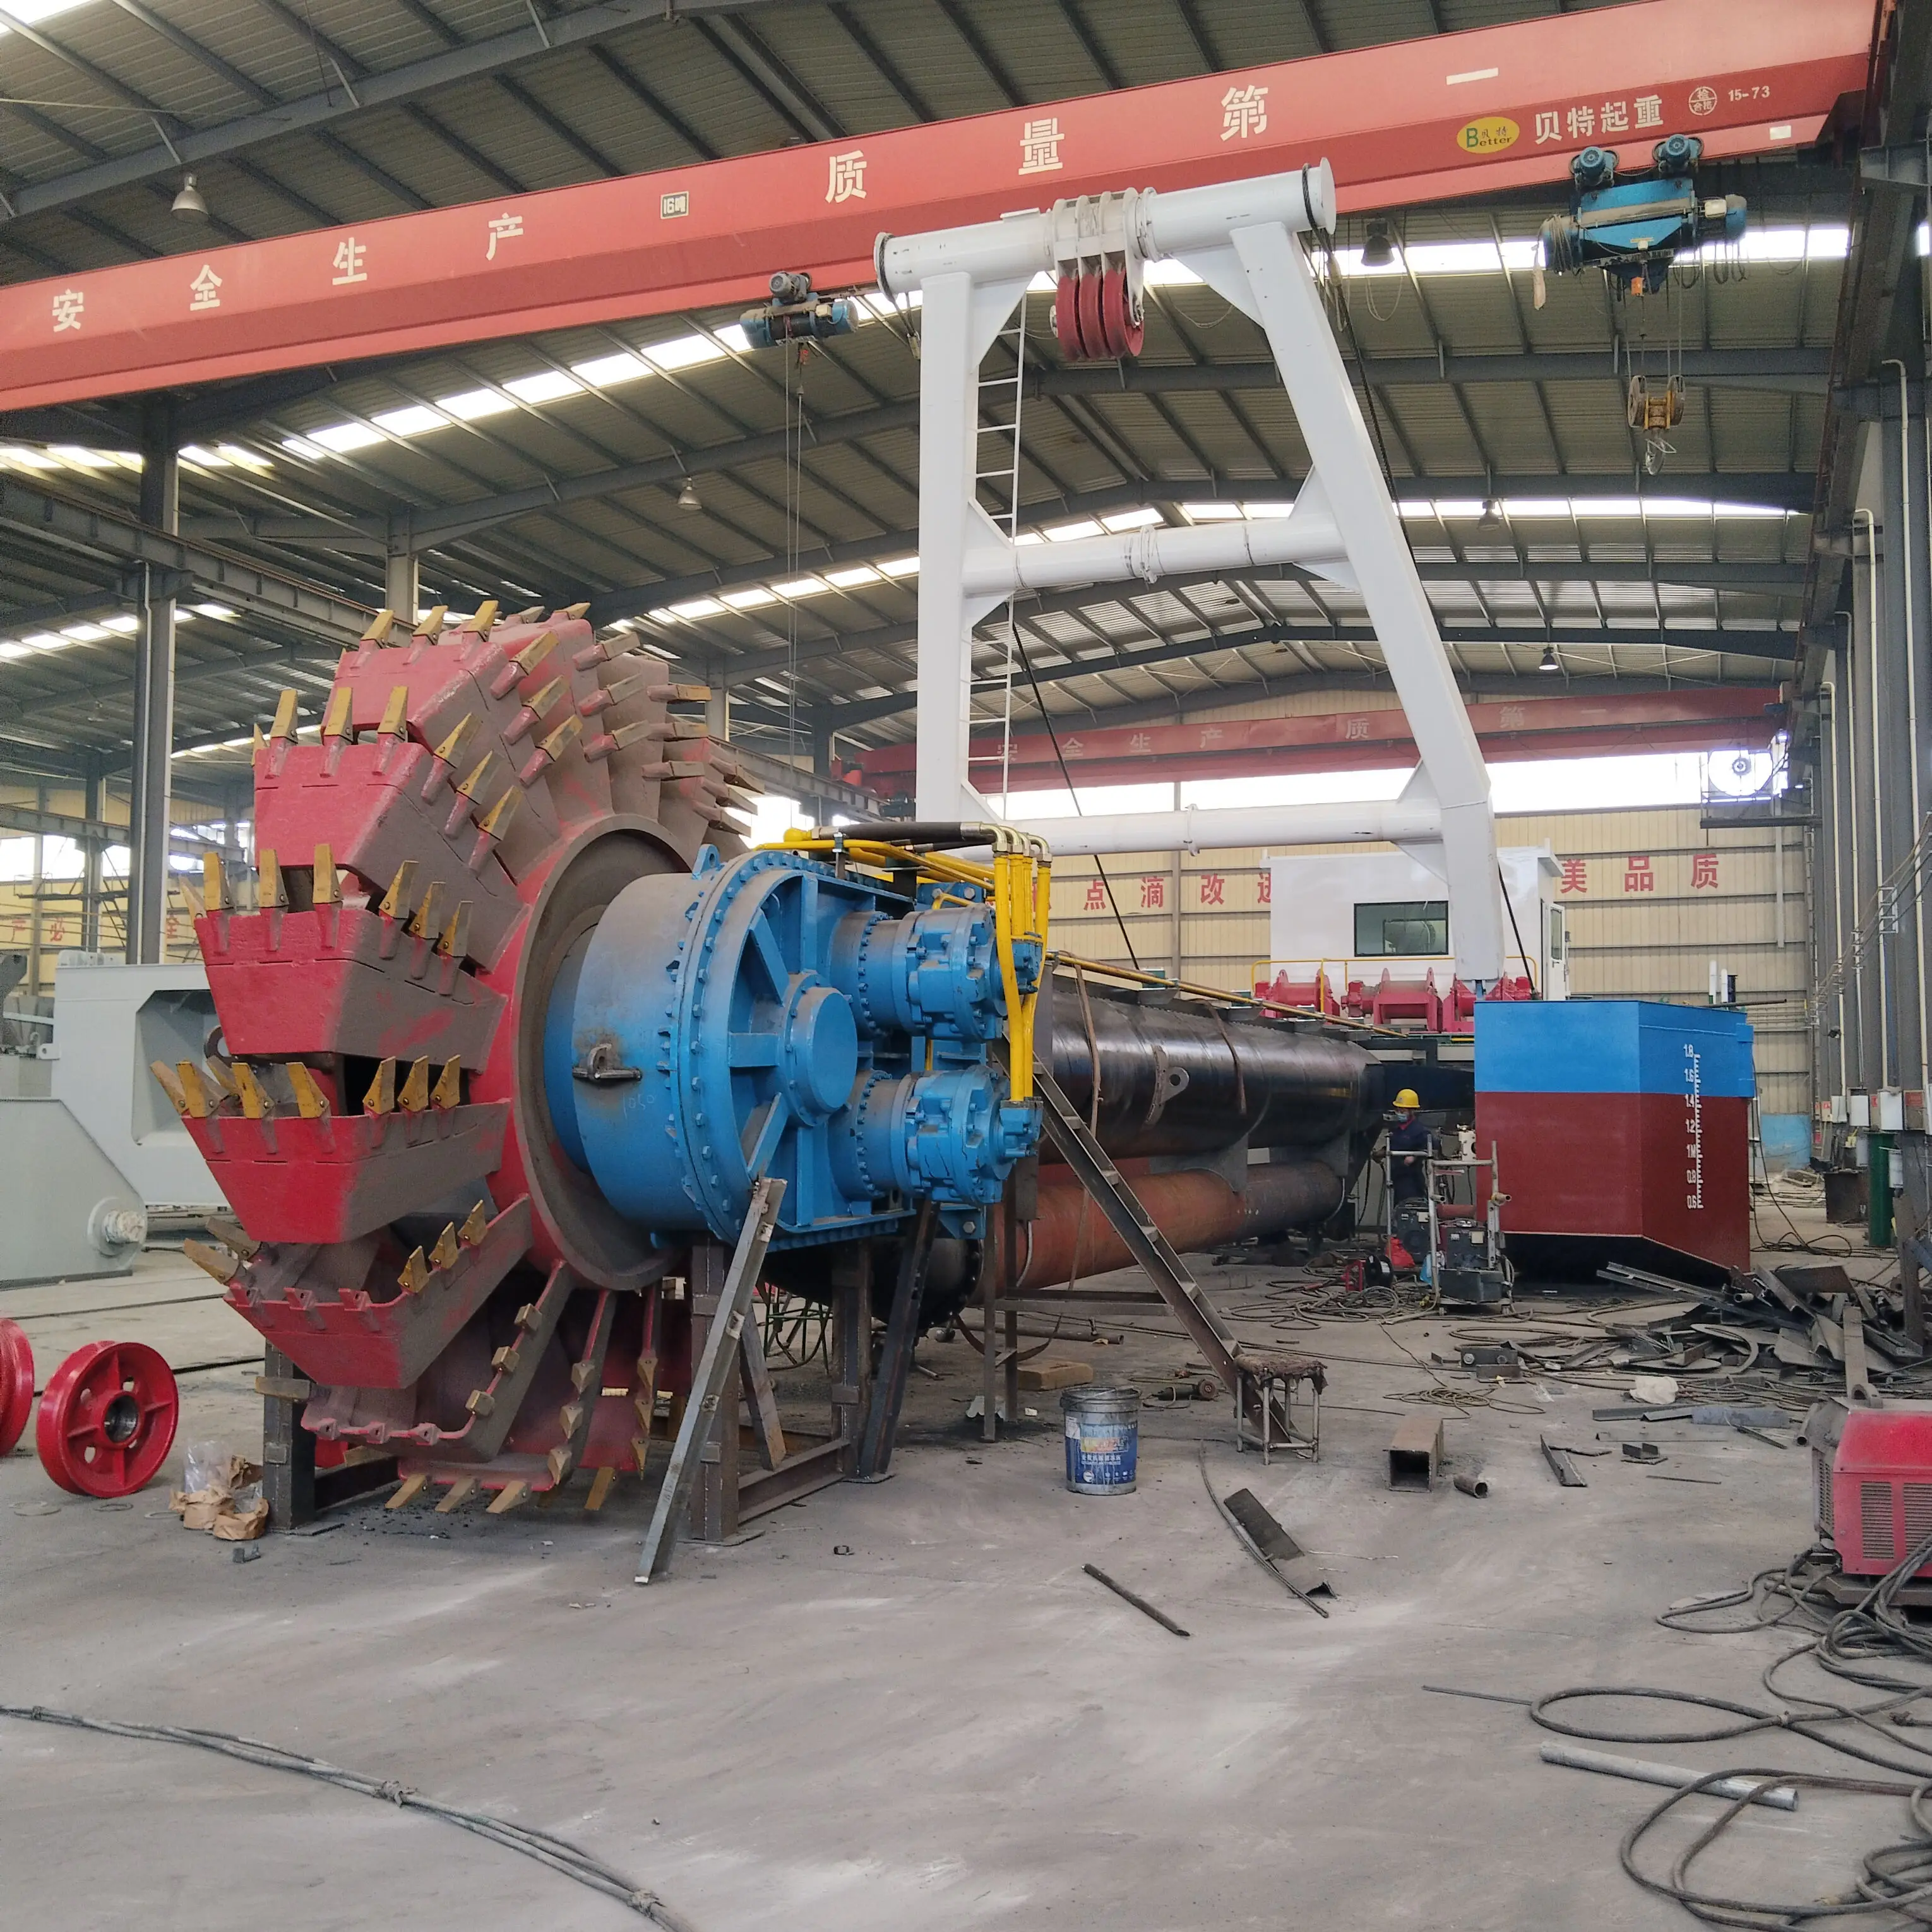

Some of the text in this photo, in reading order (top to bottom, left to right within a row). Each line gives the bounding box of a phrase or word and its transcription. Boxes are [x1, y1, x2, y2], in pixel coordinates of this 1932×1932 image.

[1728, 86, 1770, 102] 15-73
[1535, 94, 1664, 145] 贝特起重
[1465, 128, 1512, 148] Better
[52, 213, 524, 333] 安全生产
